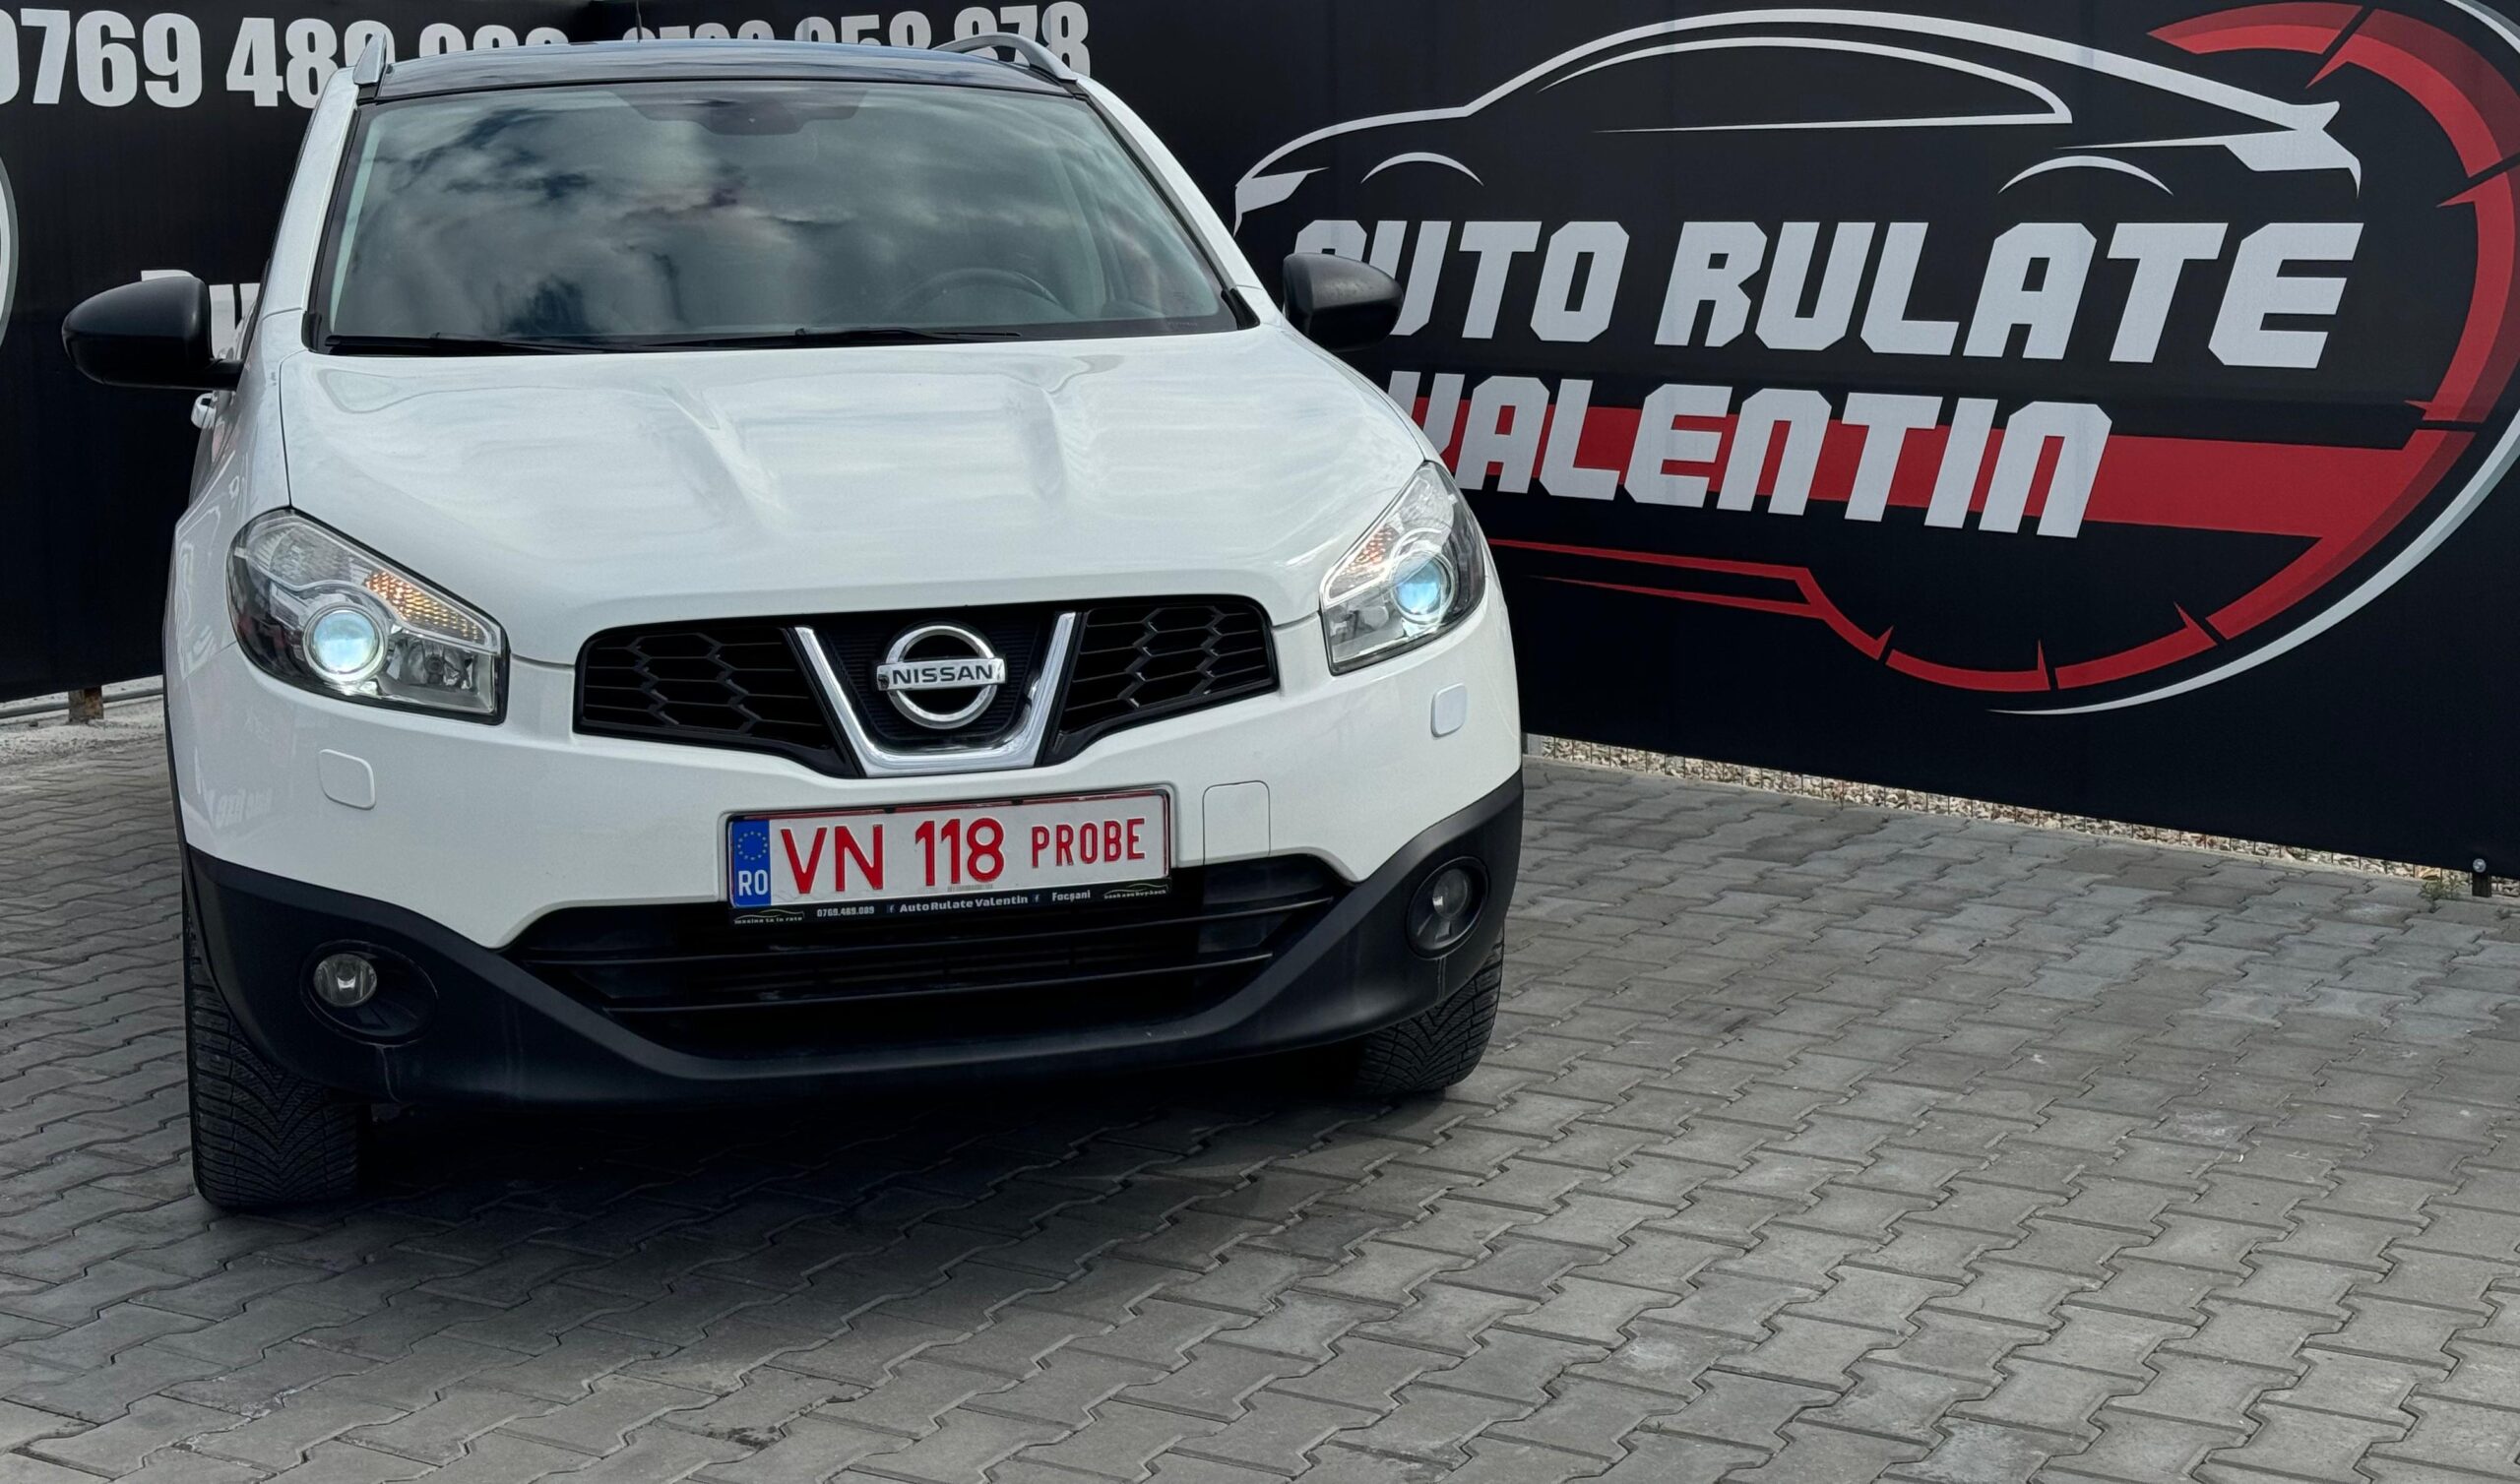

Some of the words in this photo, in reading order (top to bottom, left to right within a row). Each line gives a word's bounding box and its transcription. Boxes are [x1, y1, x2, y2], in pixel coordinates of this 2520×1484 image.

[1654, 221, 2364, 369] RULATE
[892, 664, 993, 685] NISSAN
[780, 824, 884, 895] VN
[914, 817, 1005, 887] 118
[1031, 818, 1146, 869] PROBE
[738, 869, 769, 897] RO
